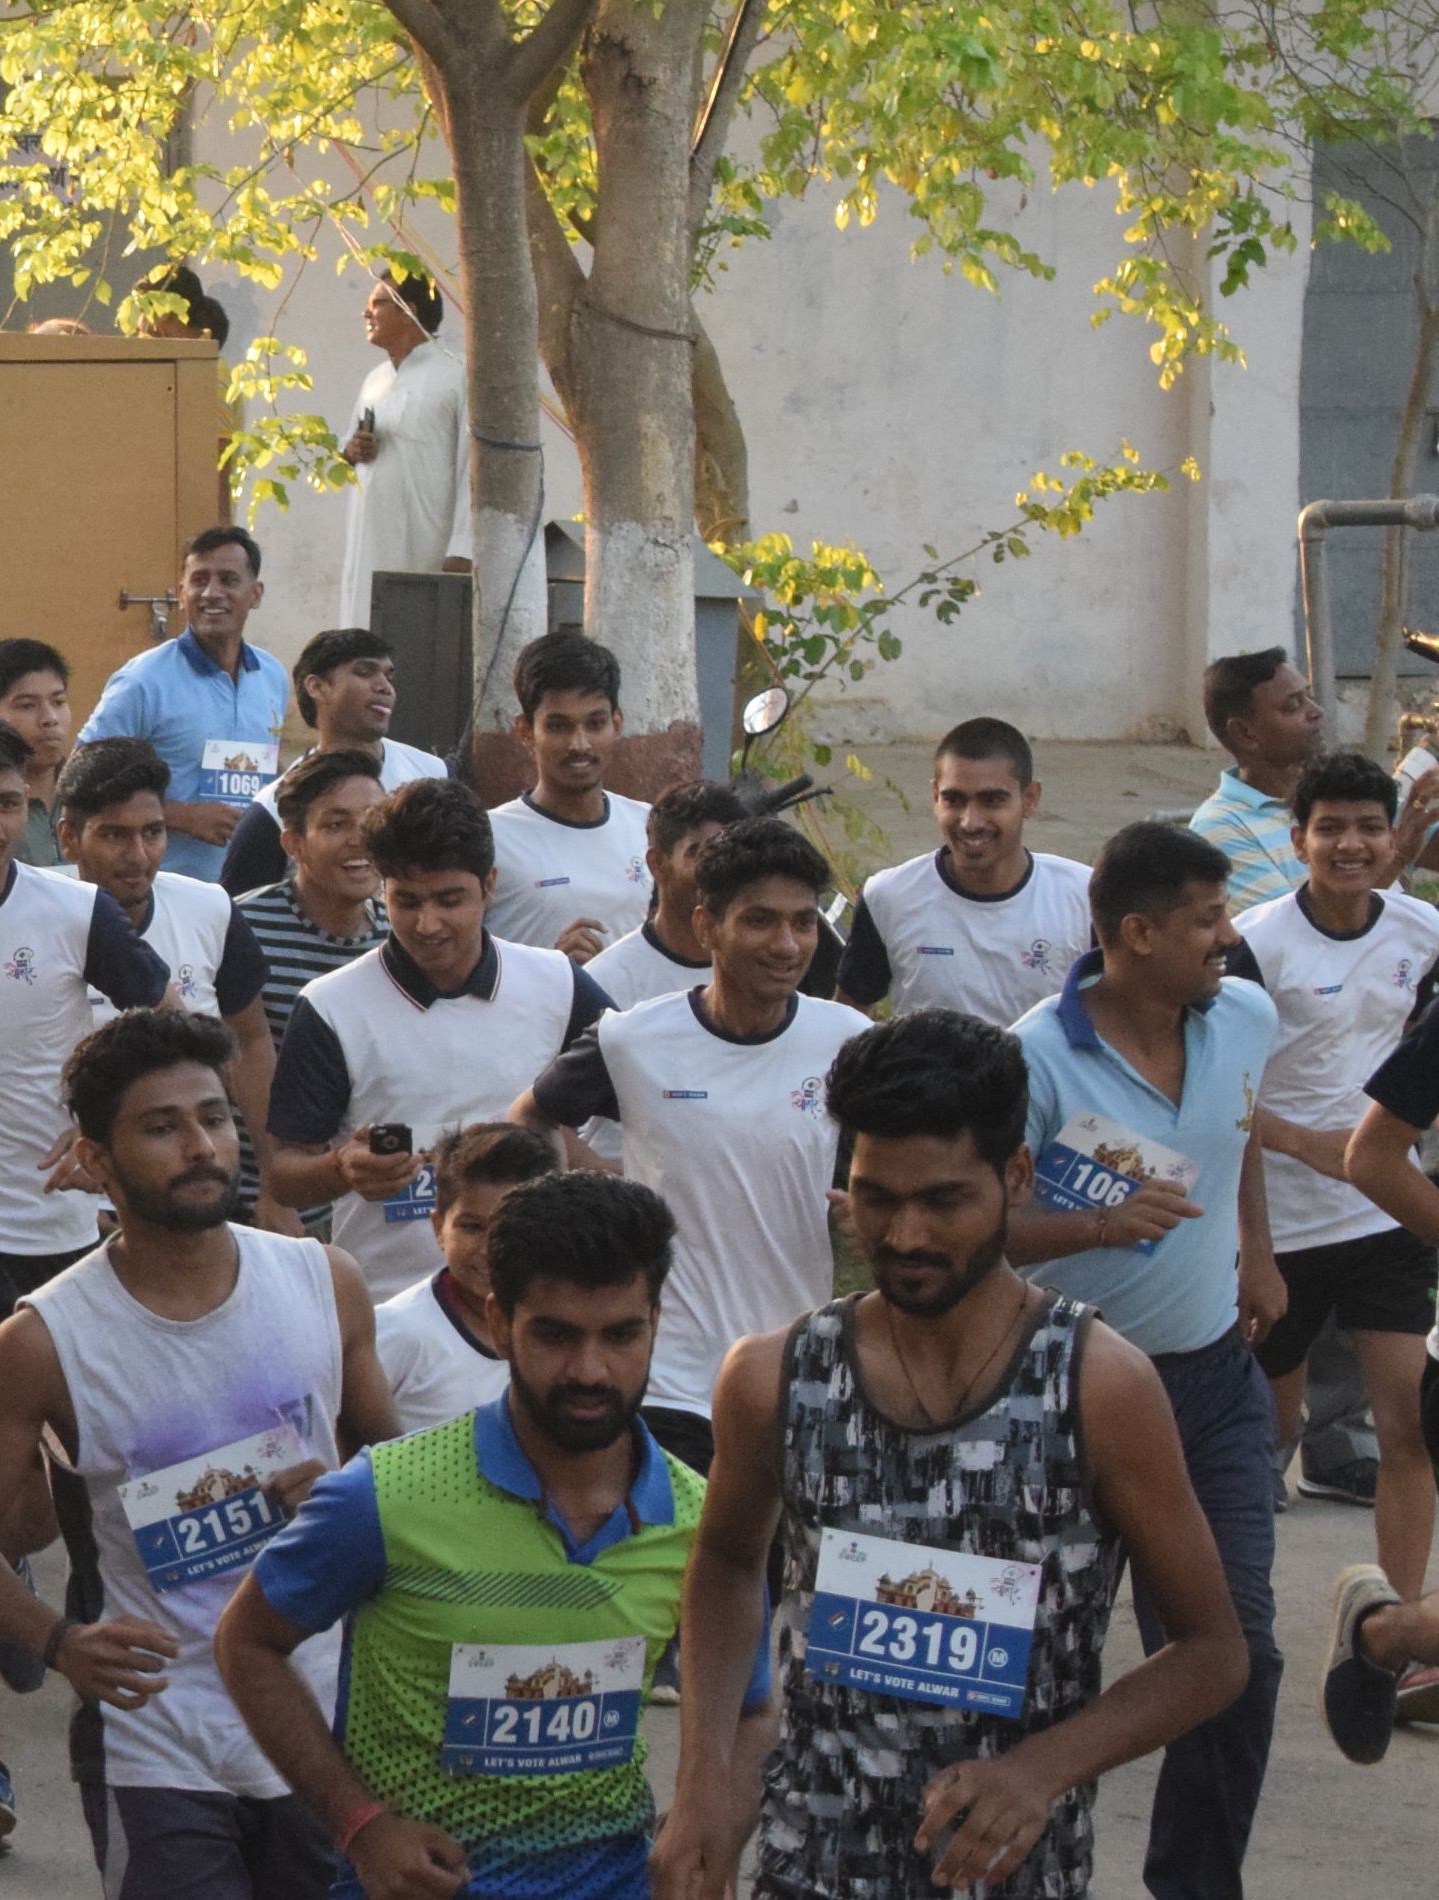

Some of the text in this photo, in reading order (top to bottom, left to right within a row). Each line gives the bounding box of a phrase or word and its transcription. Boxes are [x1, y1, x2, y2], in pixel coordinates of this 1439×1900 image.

[219, 772, 260, 796] 1069
[178, 1496, 270, 1551] 2151
[188, 1562, 215, 1576] LET'S
[859, 1610, 978, 1670] 2319
[849, 1667, 881, 1684] LET'S
[884, 1675, 915, 1690] VOTE
[918, 1682, 960, 1698] ALWAR
[493, 1701, 595, 1745] 2140
[484, 1758, 514, 1768] LET'S
[517, 1758, 545, 1768] VOTE
[548, 1754, 582, 1767] ALWAR
